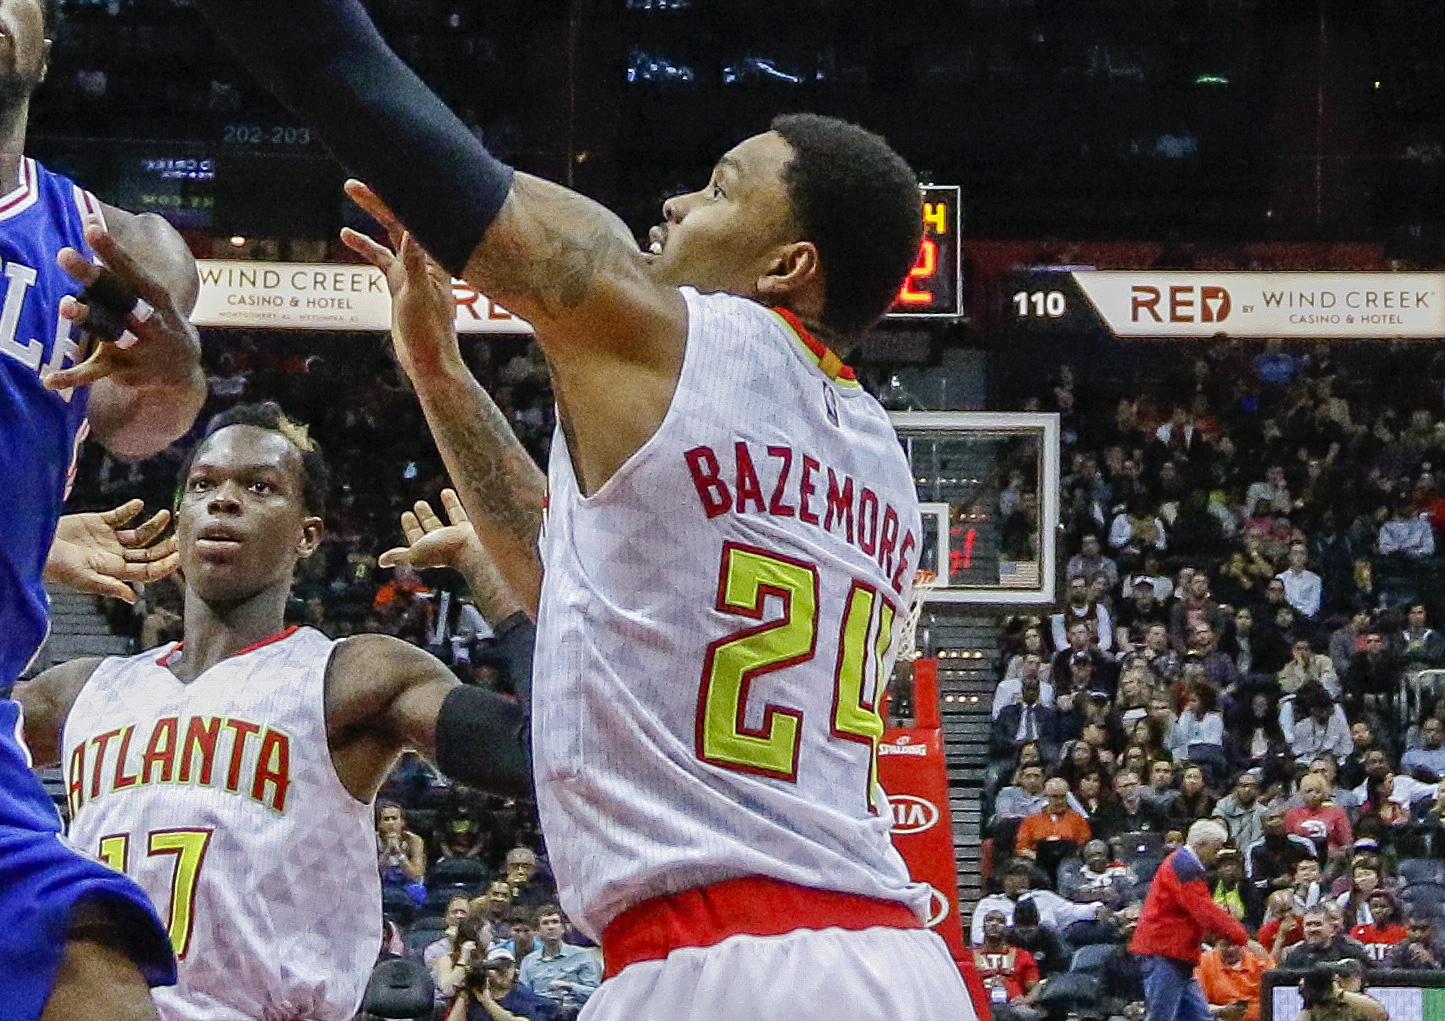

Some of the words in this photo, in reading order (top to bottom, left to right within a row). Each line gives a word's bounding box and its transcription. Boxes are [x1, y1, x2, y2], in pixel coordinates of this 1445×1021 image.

[199, 268, 281, 290] WIND
[290, 270, 384, 294] CREEK
[227, 293, 284, 308] CASINO
[289, 296, 300, 308] &
[306, 296, 354, 310] HOTEL
[1013, 291, 1066, 318] 110
[1130, 285, 1233, 323] RED
[1262, 290, 1337, 309] WIND
[1345, 290, 1430, 309] CREEK
[1288, 313, 1341, 325] CASINO
[1360, 313, 1404, 325] HOTEL
[67, 715, 292, 821] ATLANTA
